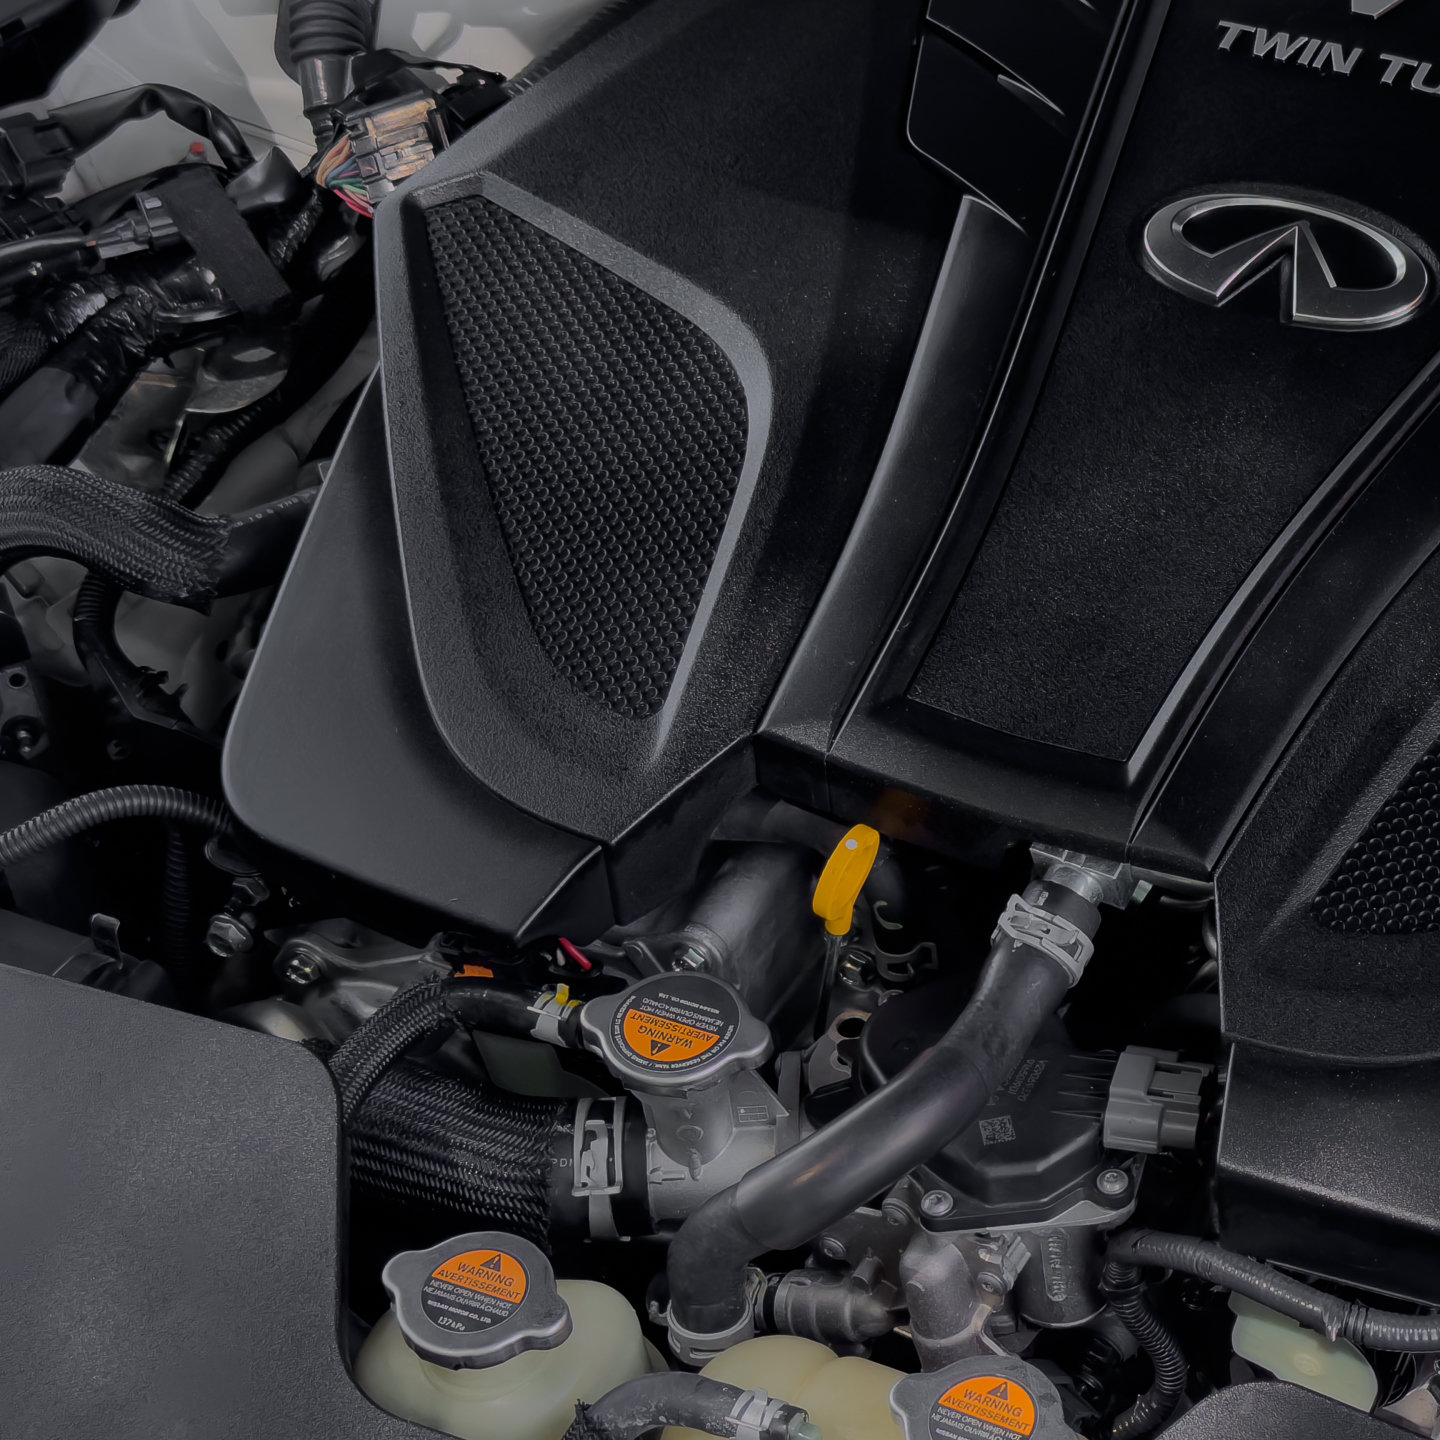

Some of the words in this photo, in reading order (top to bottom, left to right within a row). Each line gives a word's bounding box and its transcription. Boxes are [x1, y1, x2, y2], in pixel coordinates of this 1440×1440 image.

[1217, 20, 1363, 75] TWIN
[654, 1009, 675, 1018] WHEN
[676, 1015, 695, 1024] OPEN
[630, 1012, 713, 1042] AVERTISSEMENT
[637, 1025, 692, 1047] WARNING
[695, 1021, 717, 1031] NEVER
[437, 1269, 520, 1299] AVERTISSEMENT
[457, 1262, 514, 1286] WARNING
[430, 1279, 454, 1291] NEVER
[453, 1287, 472, 1297] OPEN
[474, 1294, 494, 1304] WHEN
[427, 1300, 448, 1309] NISSAN
[448, 1306, 468, 1315] MOTOR
[943, 1395, 1030, 1431] AVERTISSEMENT
[963, 1389, 1023, 1417] WARNING
[935, 1428, 957, 1438] NISSAN
[937, 1407, 961, 1419] NEVER
[961, 1415, 981, 1427] OPEN
[982, 1423, 1005, 1435] WHEN
